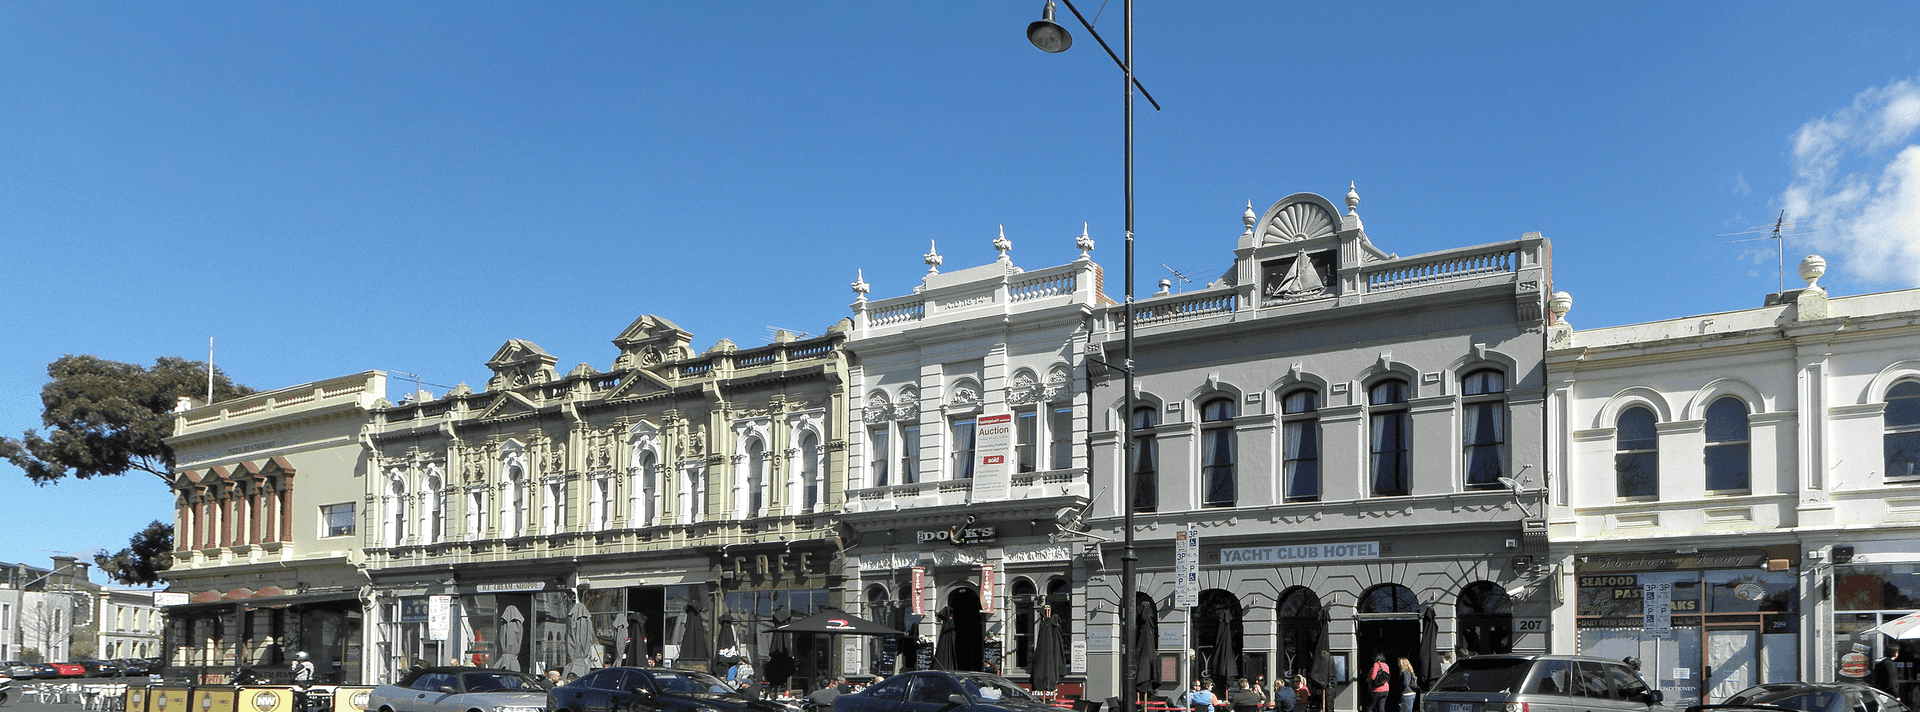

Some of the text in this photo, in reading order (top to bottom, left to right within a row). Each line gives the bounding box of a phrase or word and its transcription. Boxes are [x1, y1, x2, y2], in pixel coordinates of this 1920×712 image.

[979, 427, 1009, 436] Auction
[1189, 530, 1198, 538] 3P
[1223, 543, 1377, 561] YACHT CLUB HOTEL
[735, 552, 812, 575] CAFE
[1599, 553, 1744, 569] Abalone King
[1582, 576, 1634, 586] SEAFOOD
[1520, 621, 1542, 630] 207
